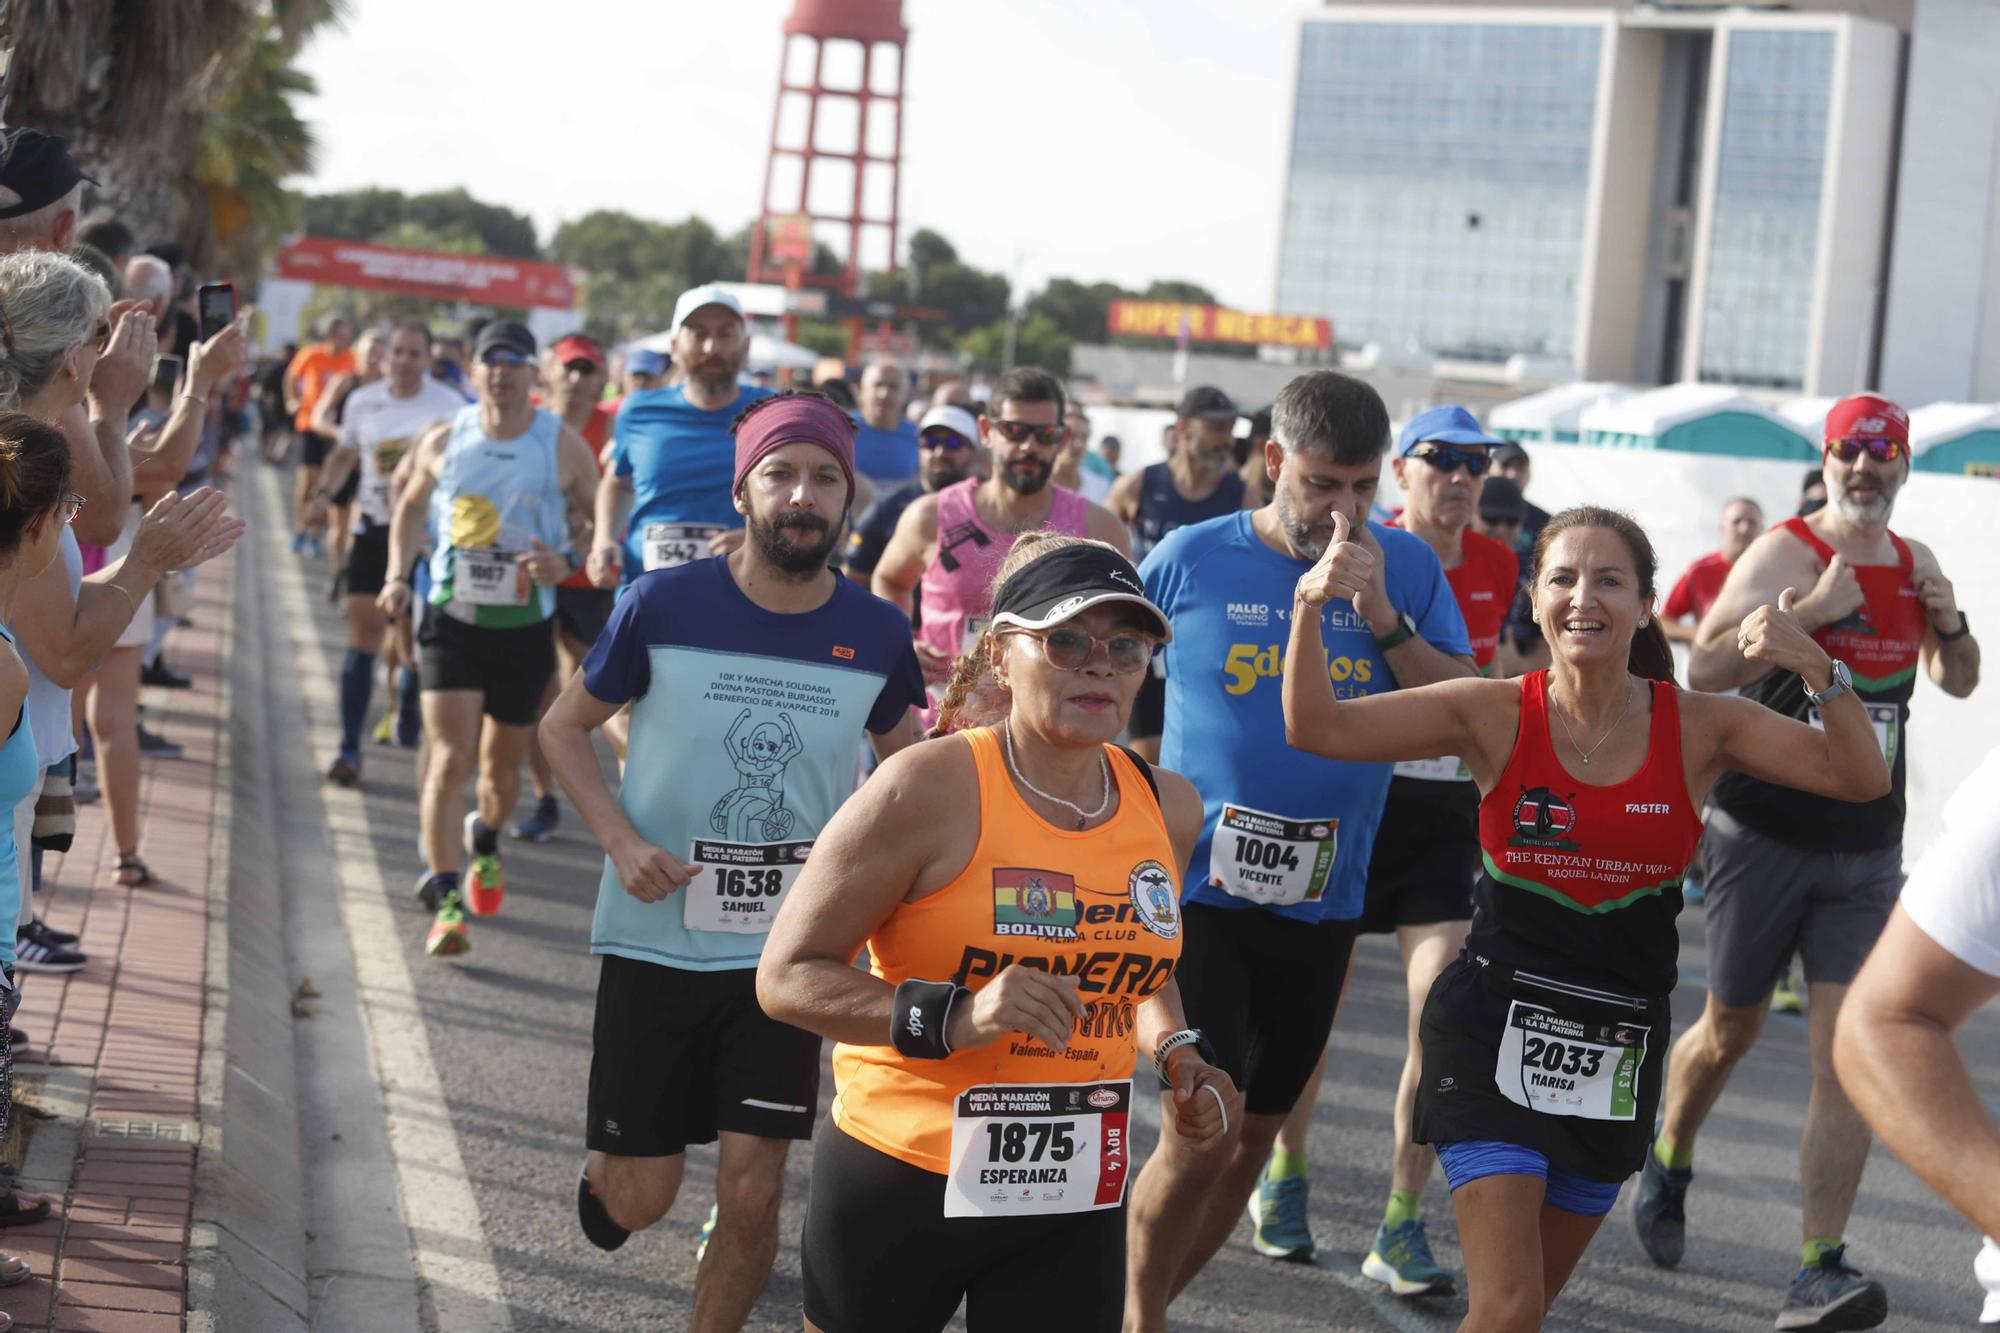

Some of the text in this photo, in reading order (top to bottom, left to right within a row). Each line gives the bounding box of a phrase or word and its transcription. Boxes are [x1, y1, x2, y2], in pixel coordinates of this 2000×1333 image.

[1227, 603, 1269, 614] PALEO
[1227, 613, 1269, 622] TRAINING
[1224, 643, 1374, 696] 5dos
[719, 672, 735, 681] 10K
[744, 675, 783, 688] MARCHA
[785, 681, 831, 695] SOLIDARIA
[710, 682, 837, 706] DIVINA PASTORA BURJASSOT
[703, 692, 840, 718] A BENEFICIO DE AVAPACE 2018
[1625, 803, 1670, 814] FASTER
[702, 845, 764, 856] MEDIA MARATÓN
[702, 852, 719, 860] VILA
[732, 855, 765, 863] PATERNA
[1235, 835, 1299, 872] 1004
[1506, 851, 1672, 875] THE KENYAN URBAN WAY
[715, 868, 783, 898] 1638
[1239, 867, 1284, 886] VICENTE
[1547, 869, 1630, 884] RAQUEL LANDIN
[722, 901, 766, 913] SAMUEL
[995, 923, 1077, 938] BOLIVIA
[1094, 929, 1137, 941] CLUB
[906, 1005, 924, 1037] edp
[1539, 1022, 1549, 1031] DE
[1550, 1025, 1584, 1038] PATERNA
[1009, 1042, 1056, 1058] Valencia
[1064, 1047, 1099, 1062] España
[1523, 1037, 1605, 1078] 2033
[1530, 1072, 1576, 1092] MARISA
[1618, 1059, 1634, 1089] BOX 3
[969, 1093, 998, 1102] MEDIA
[1001, 1091, 1050, 1102] MARATÓN
[969, 1102, 1051, 1112] VILA DE PATERNA
[987, 1121, 1075, 1163] 1875
[1107, 1128, 1121, 1157] BOX
[980, 1168, 1067, 1184] ESPERANZA
[1107, 1161, 1121, 1172] 4
